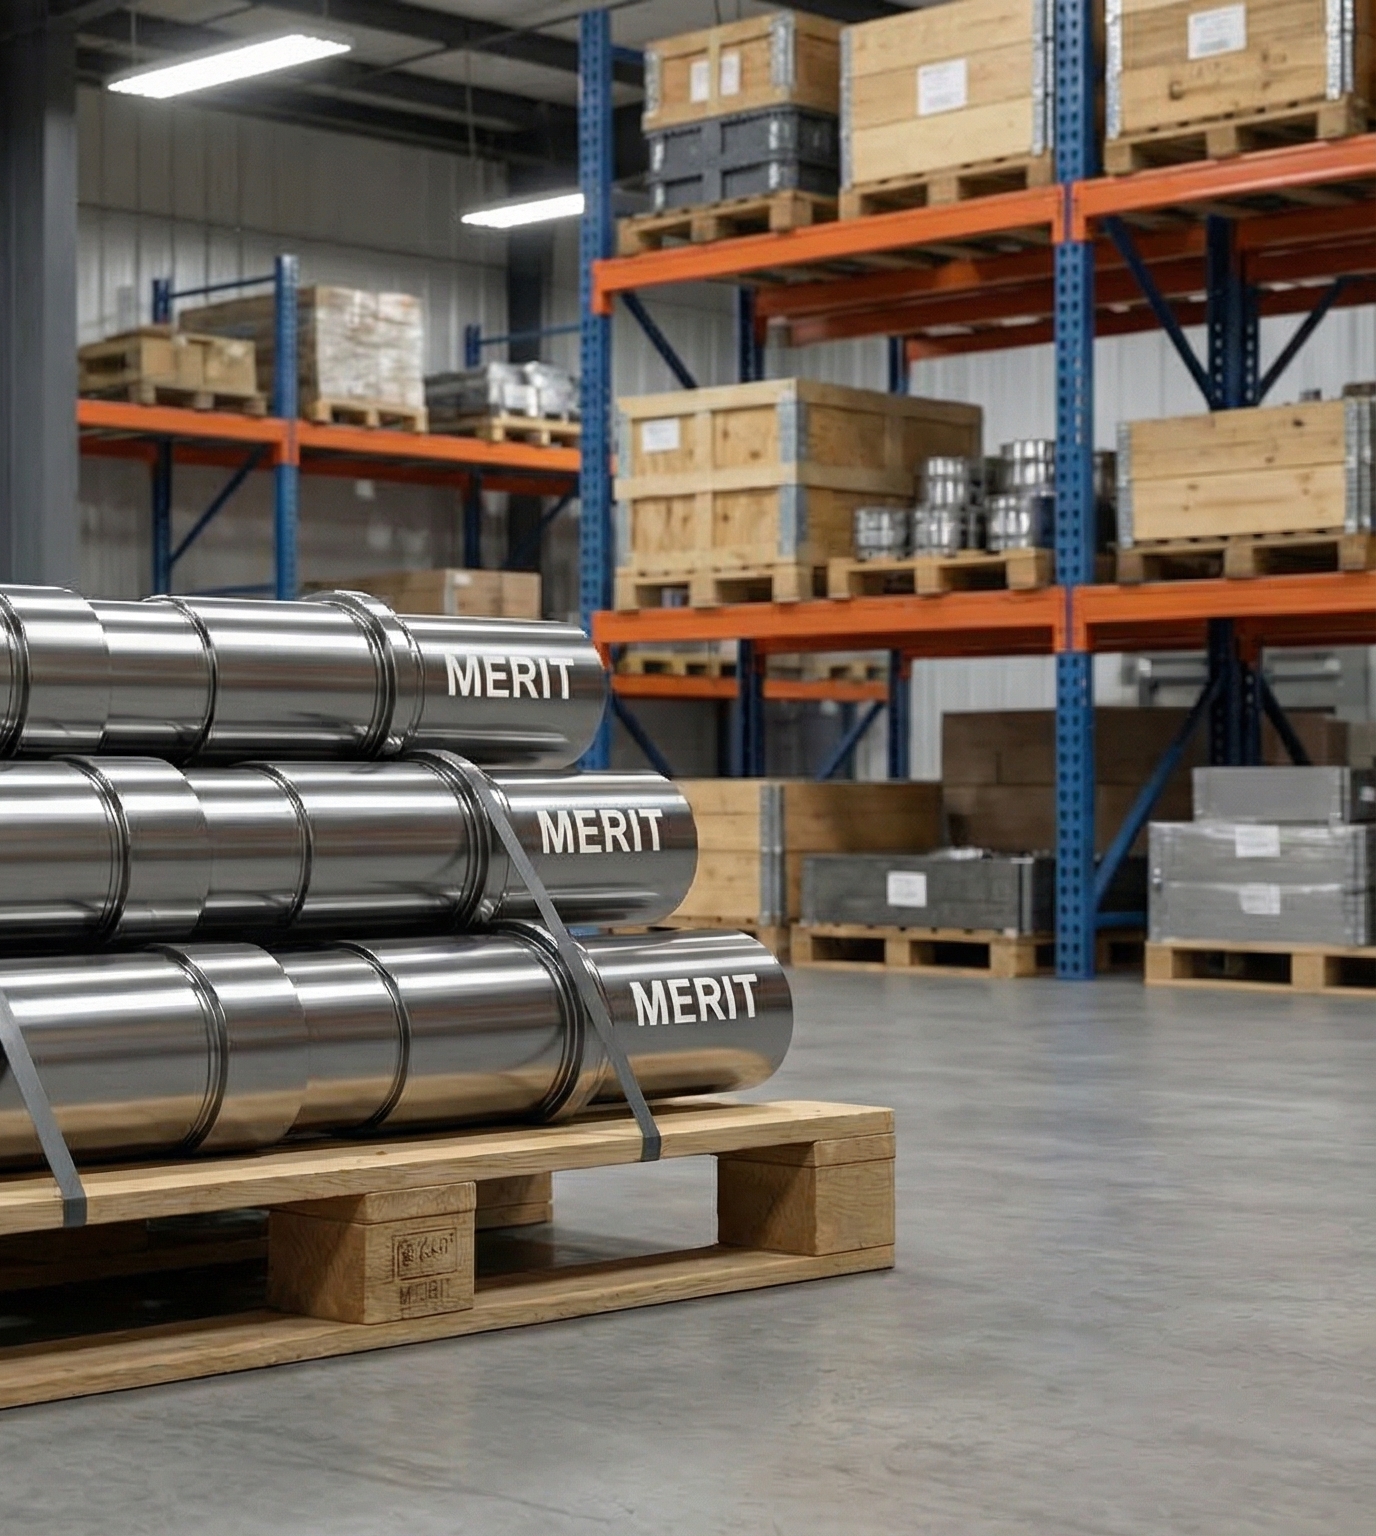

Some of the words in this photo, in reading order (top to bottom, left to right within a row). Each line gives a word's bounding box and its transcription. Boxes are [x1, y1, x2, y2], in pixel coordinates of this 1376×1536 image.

[445, 654, 575, 700] MERIT
[537, 808, 663, 854] MERIT
[629, 973, 757, 1026] MERIT
